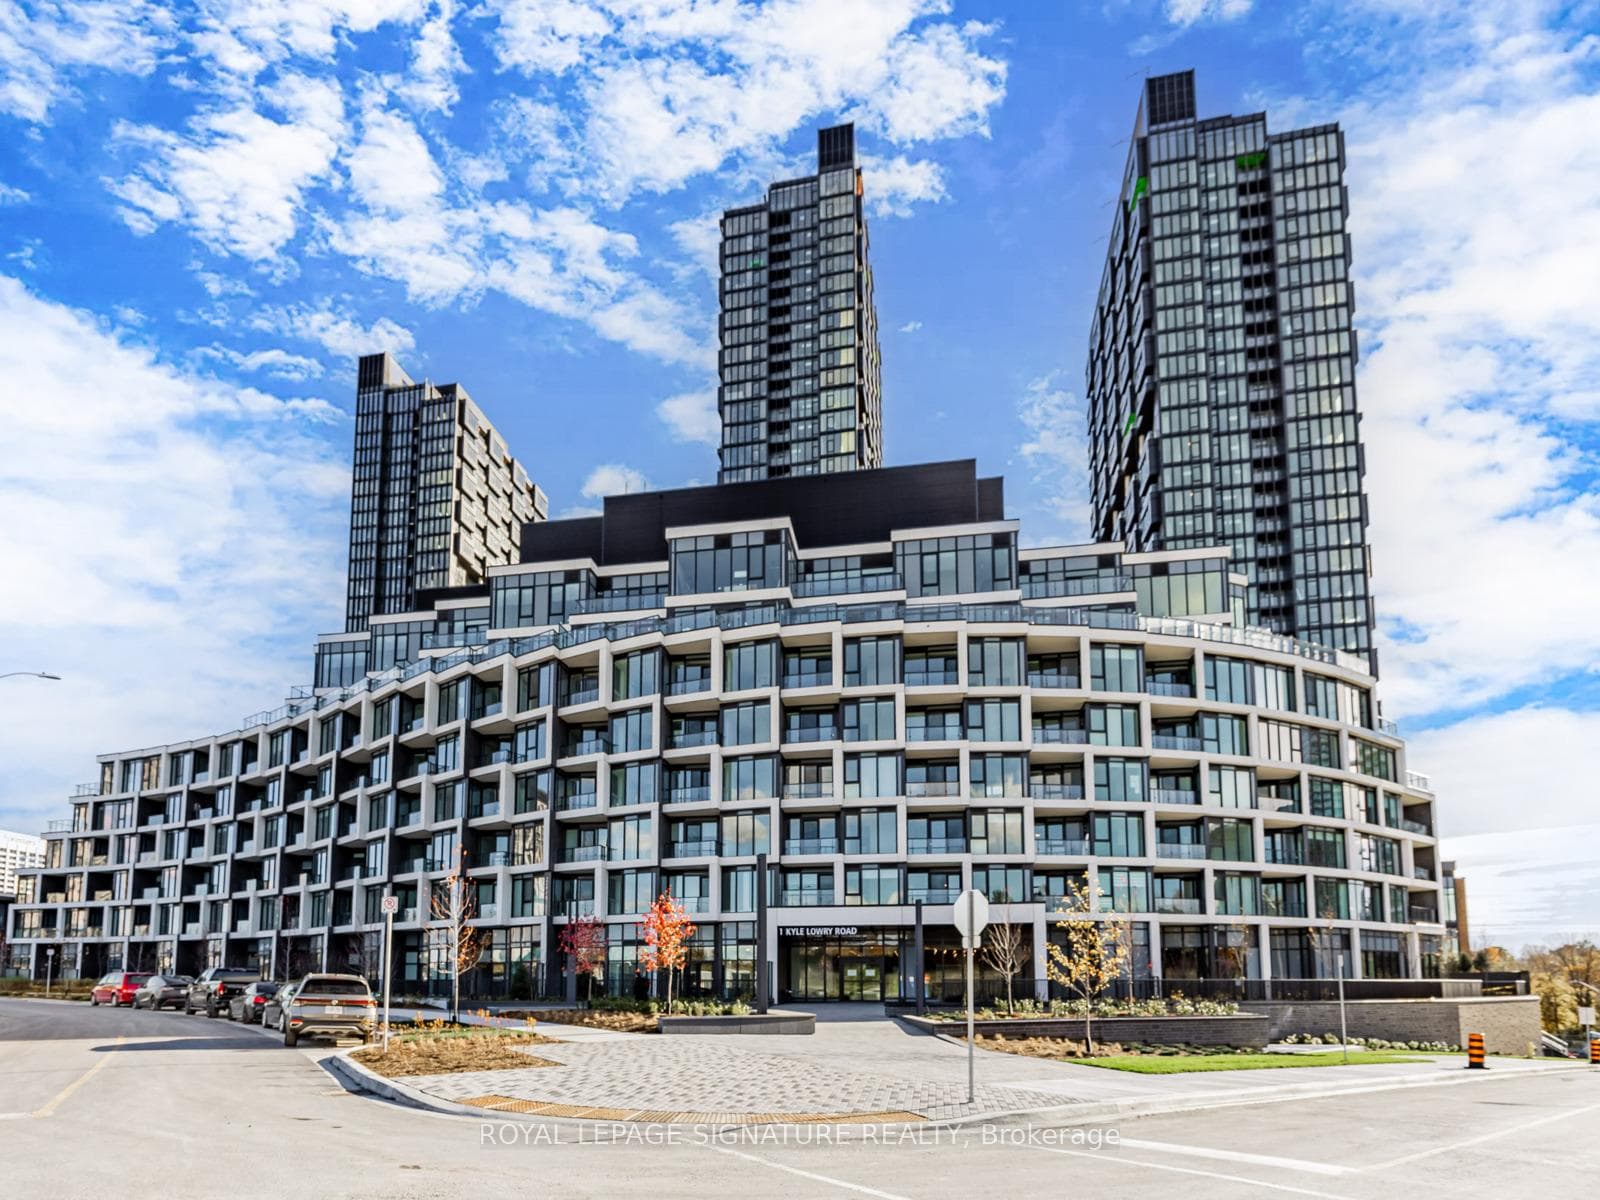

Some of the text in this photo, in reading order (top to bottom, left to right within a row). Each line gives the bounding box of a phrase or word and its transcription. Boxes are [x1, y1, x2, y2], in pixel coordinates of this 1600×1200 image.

[785, 927, 805, 936] KYLE
[806, 927, 833, 935] LOWRY
[835, 926, 857, 935] ROAD
